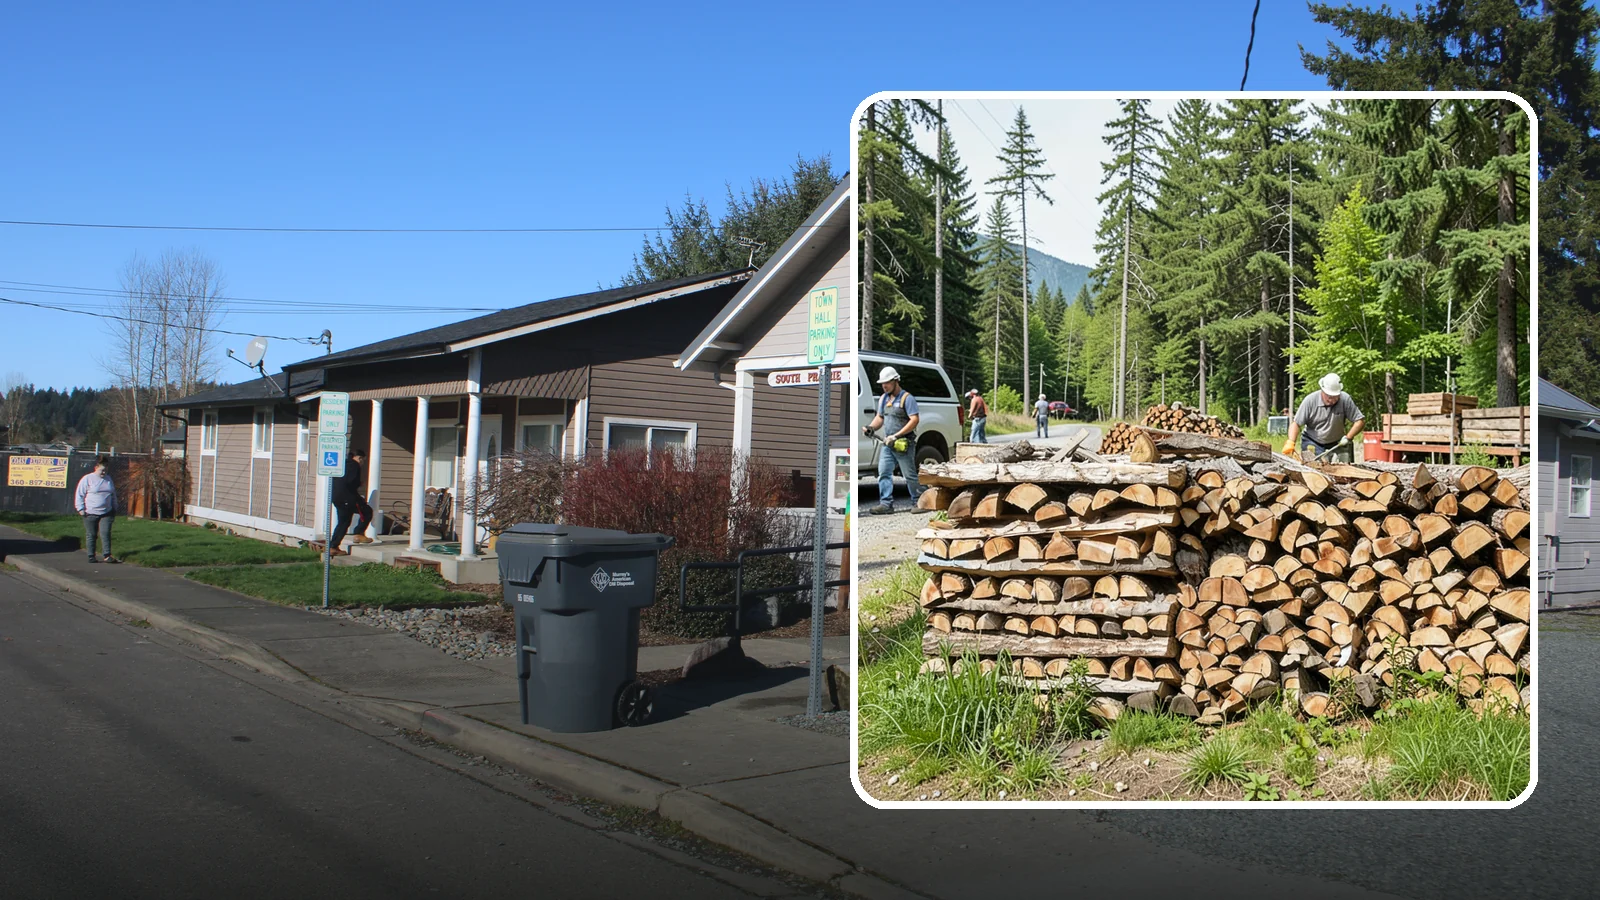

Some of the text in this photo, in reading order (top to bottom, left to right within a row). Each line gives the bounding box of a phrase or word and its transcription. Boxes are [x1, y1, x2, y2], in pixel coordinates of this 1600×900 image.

[815, 294, 833, 308] TOWN
[814, 311, 831, 325] HALL
[810, 326, 836, 341] PARKING
[813, 344, 831, 358] ONLY
[775, 373, 801, 384] SOUTH
[807, 370, 842, 382] PRIE
[322, 409, 345, 417] PARKING
